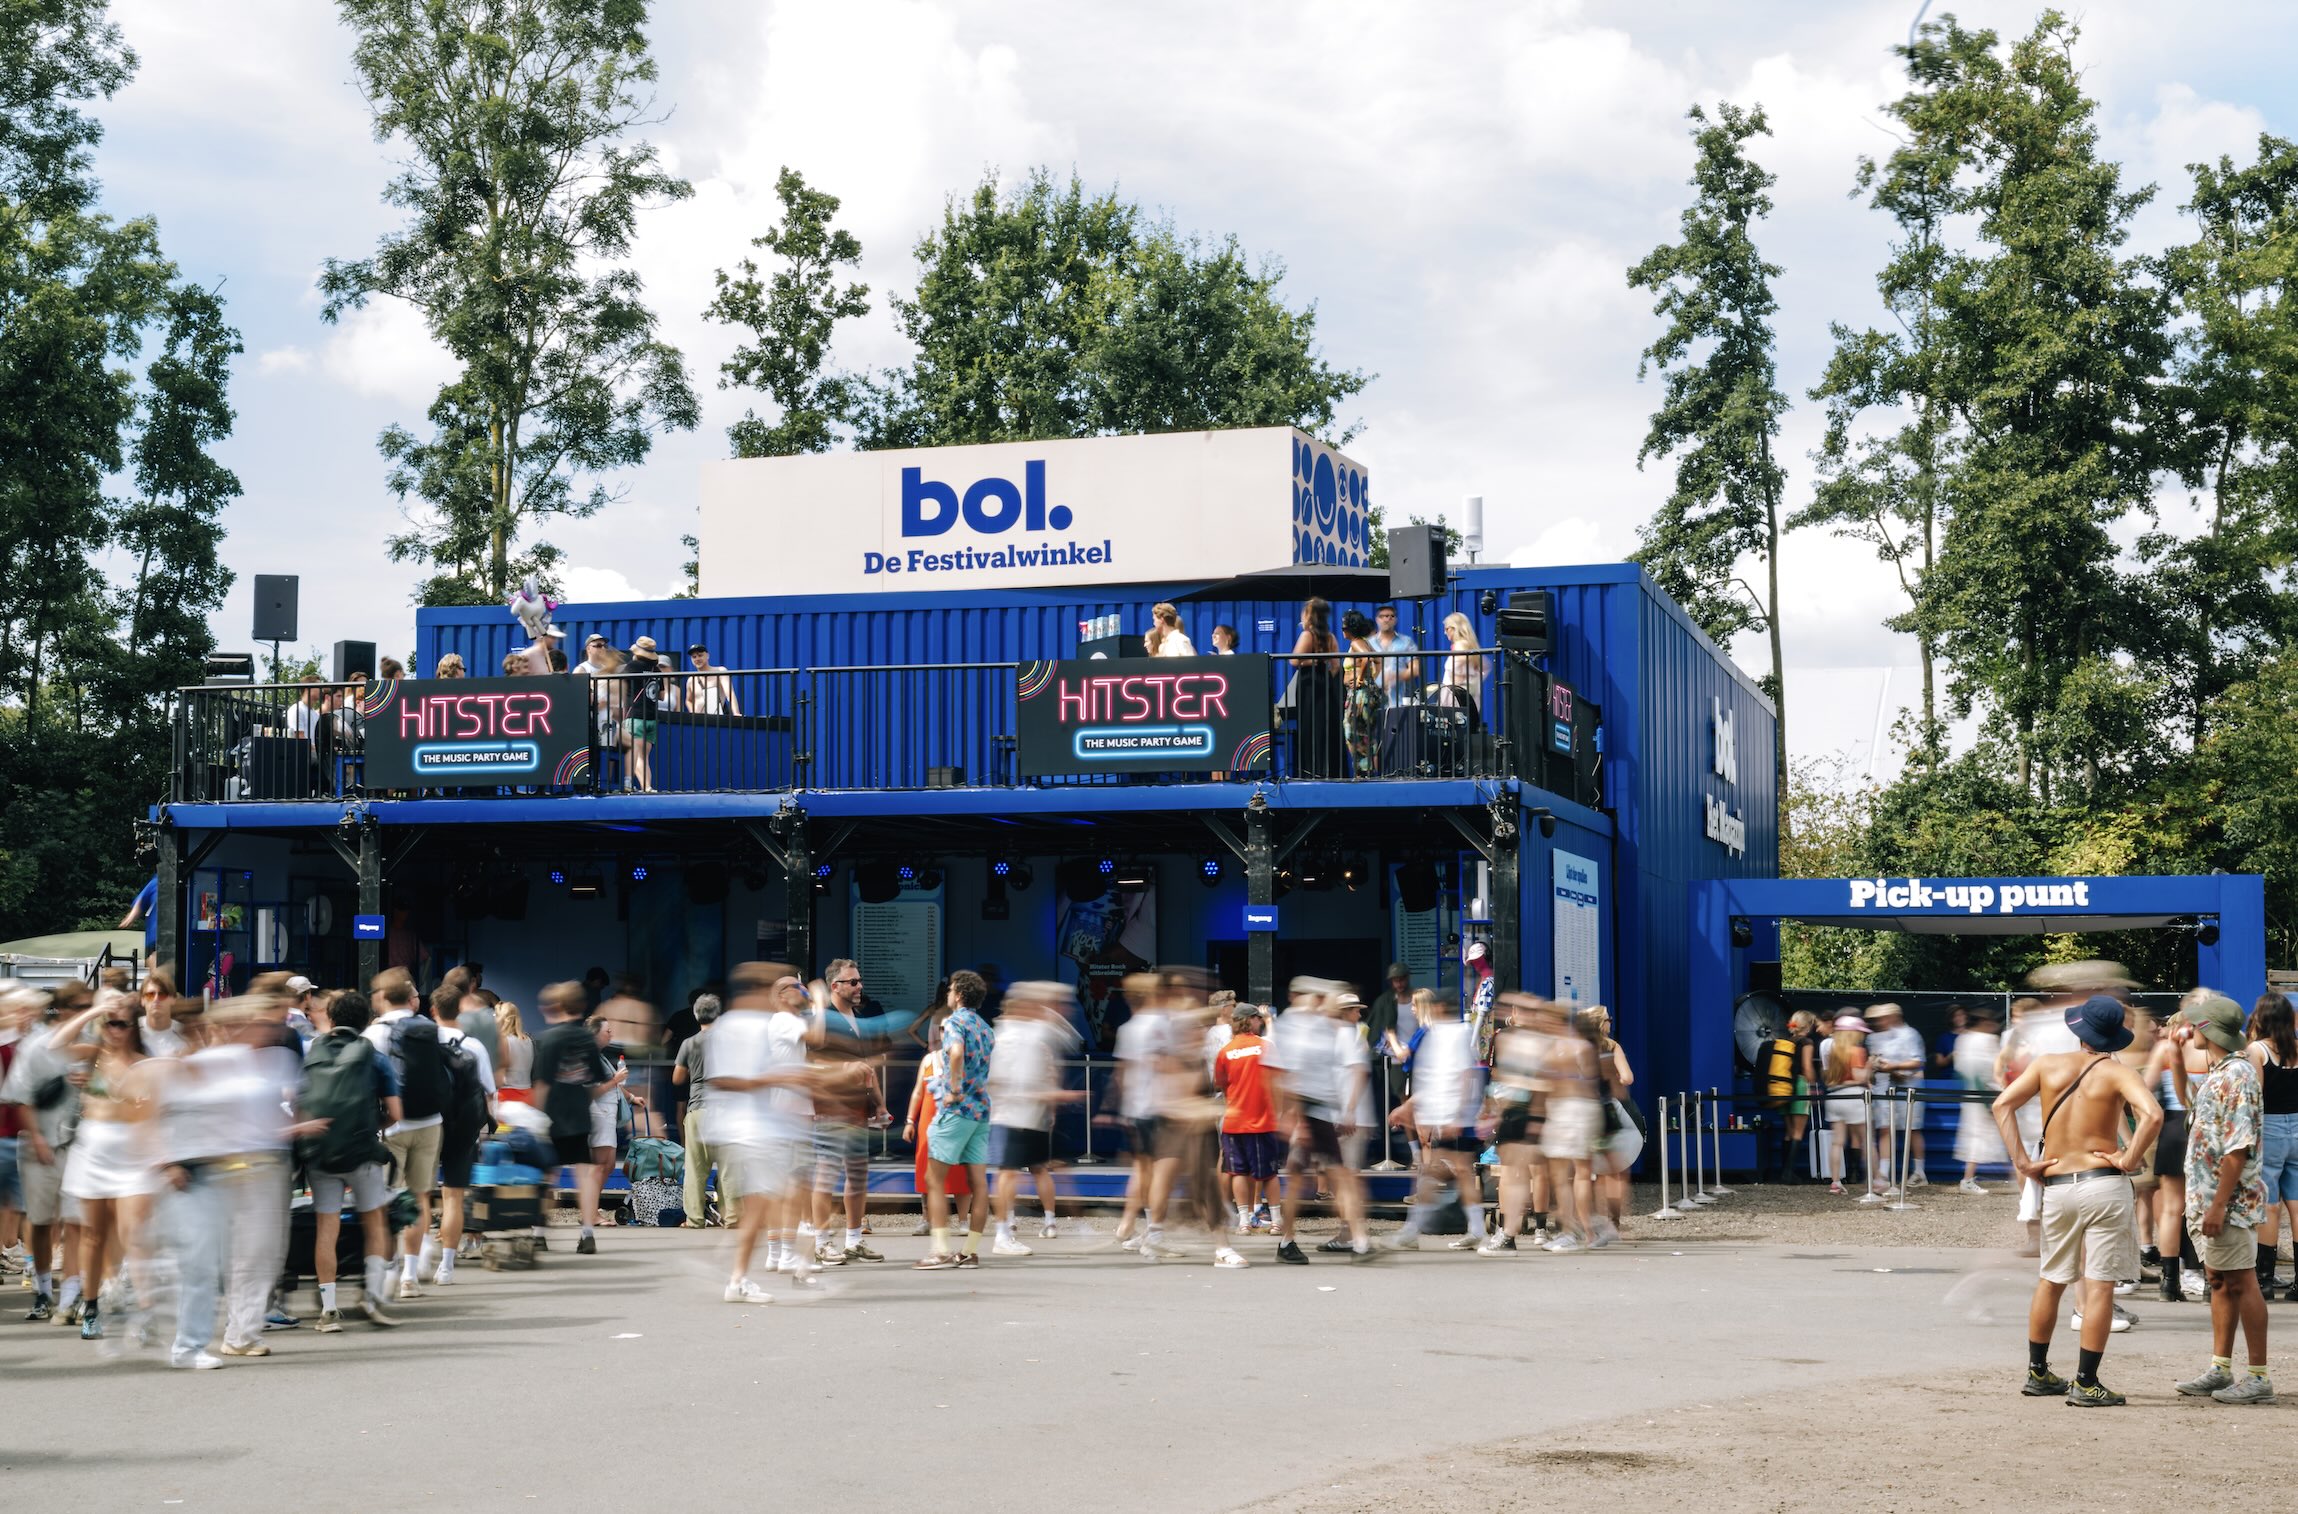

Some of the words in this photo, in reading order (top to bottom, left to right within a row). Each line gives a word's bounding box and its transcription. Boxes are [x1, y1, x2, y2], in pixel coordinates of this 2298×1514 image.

[901, 459, 1073, 538] bol.
[864, 551, 901, 574] De
[907, 539, 1112, 573] Festivalwinkel
[401, 693, 552, 737] HITSTER
[1060, 674, 1228, 722] HITSTER
[423, 754, 441, 763] THE
[442, 753, 471, 763] MUSIC
[473, 752, 501, 762] PARTY
[502, 752, 529, 761] GAME
[1085, 738, 1104, 749] THE
[1106, 738, 1138, 747] MUSIC
[1140, 737, 1172, 747] PARTY
[1173, 736, 1202, 746] GAME
[1714, 695, 1737, 786] bol.
[1850, 878, 1995, 914] Pick-up
[2000, 880, 2089, 913] punt
